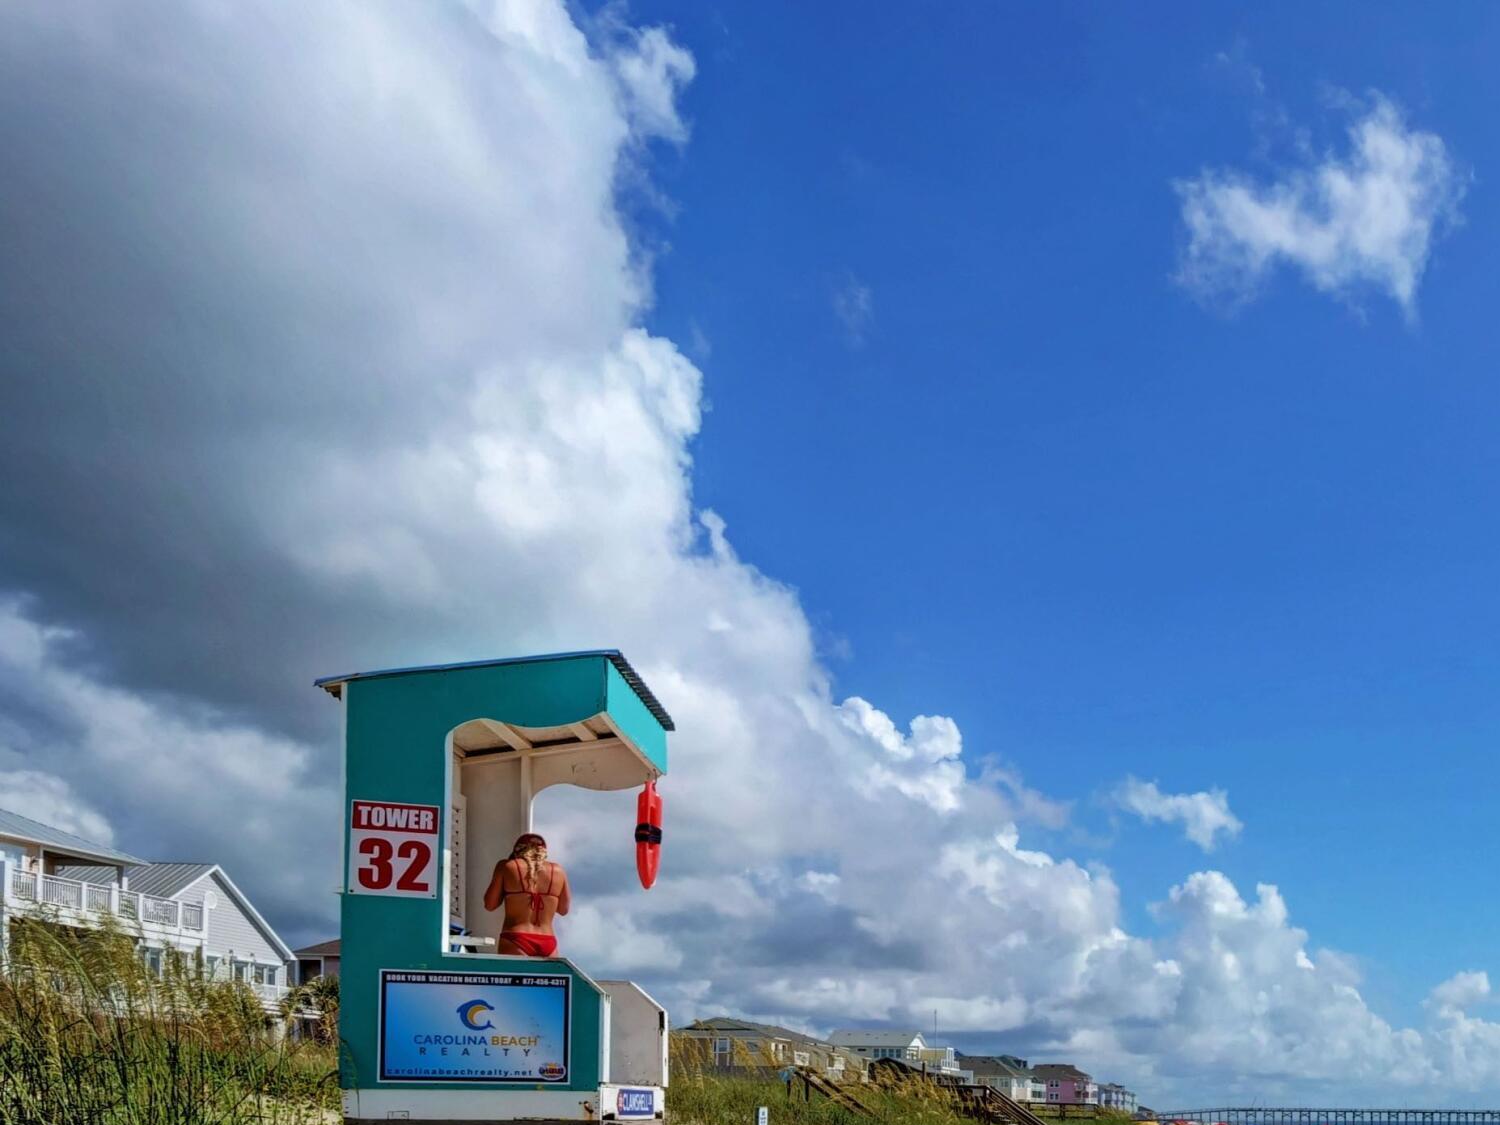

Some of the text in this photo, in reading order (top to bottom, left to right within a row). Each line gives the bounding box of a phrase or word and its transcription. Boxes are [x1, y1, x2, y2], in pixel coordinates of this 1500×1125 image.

[358, 806, 434, 830] TOWER
[358, 838, 431, 892] 32
[386, 974, 406, 982] BOOK
[407, 974, 426, 982] YOUR
[428, 975, 463, 983] VACATION
[464, 976, 489, 984] RENTAL
[490, 977, 513, 985] TODAY
[413, 1034, 537, 1046] CAROLINA BEACH
[419, 1047, 531, 1057] REALTY
[387, 1068, 532, 1077] carolinabeachrealty.net
